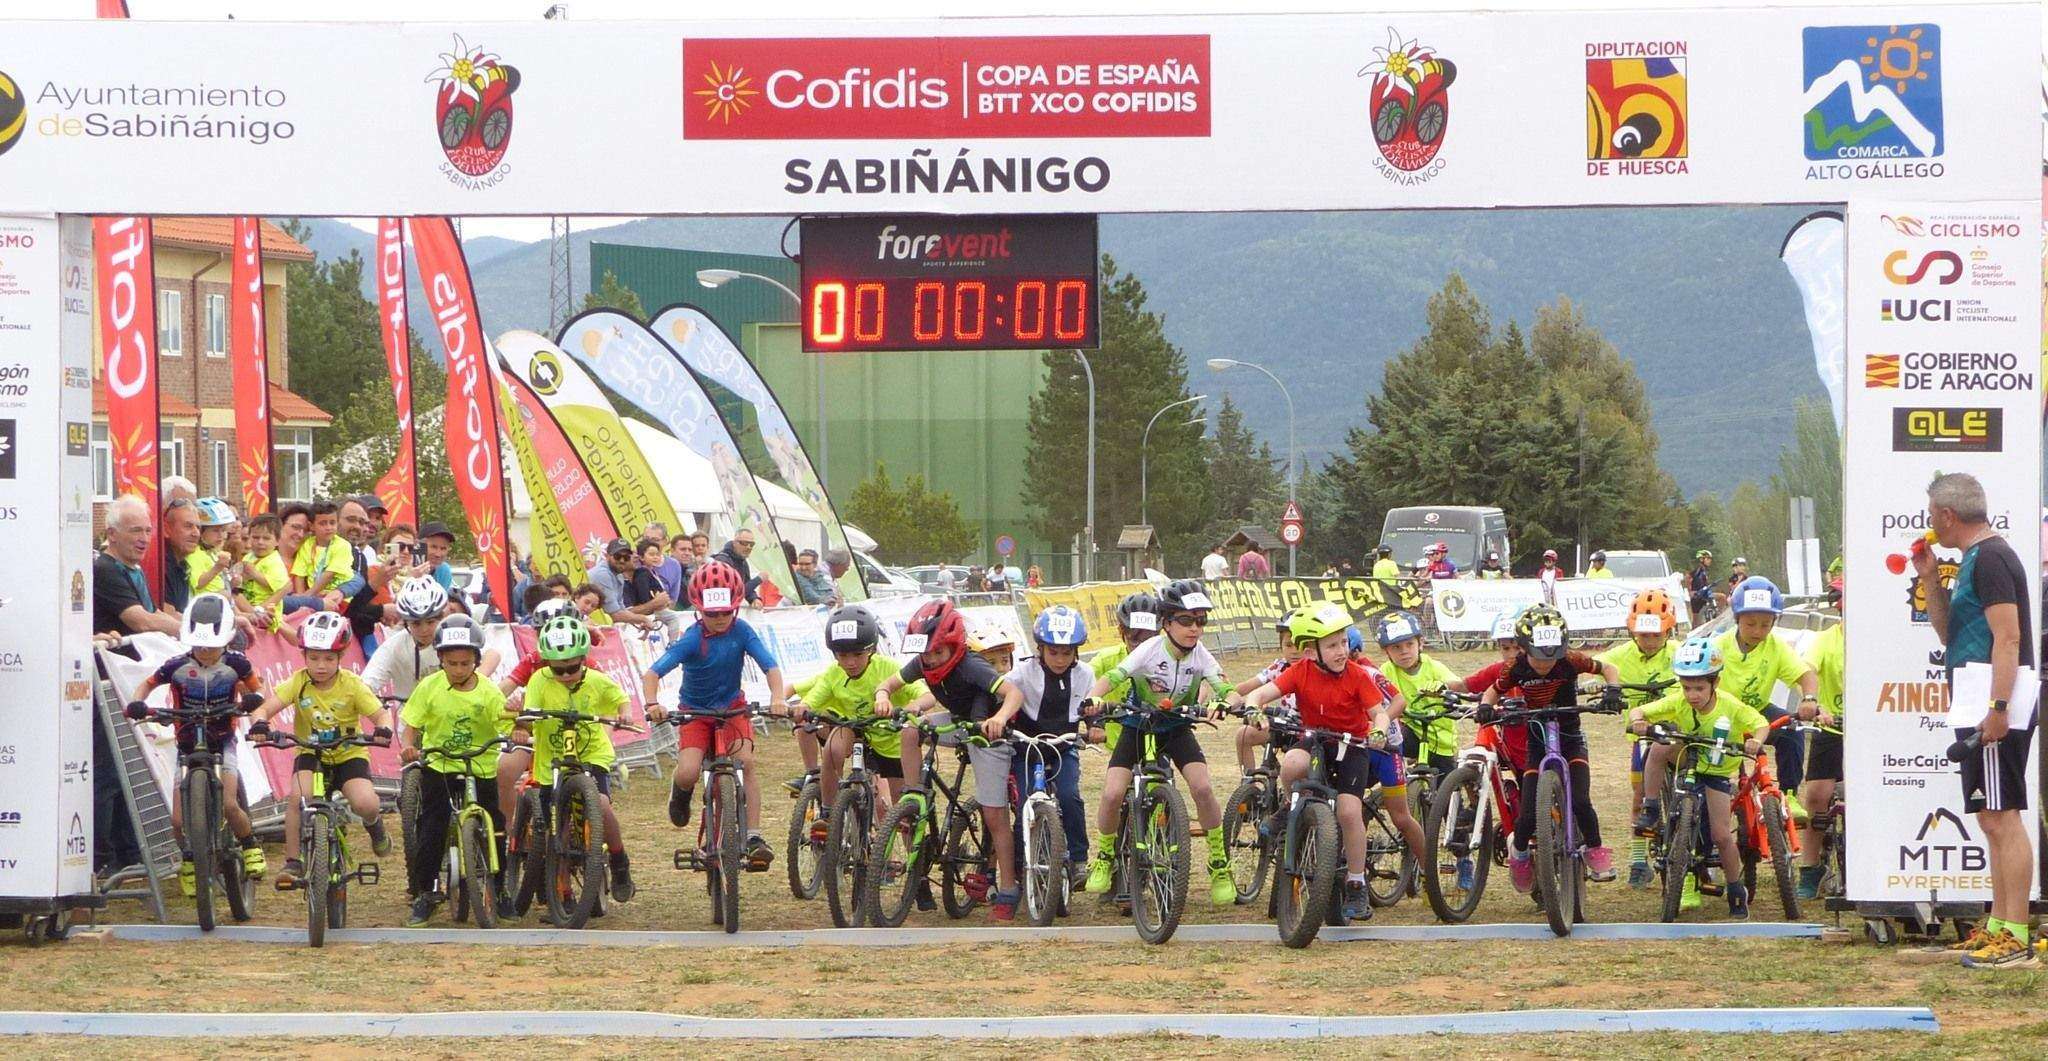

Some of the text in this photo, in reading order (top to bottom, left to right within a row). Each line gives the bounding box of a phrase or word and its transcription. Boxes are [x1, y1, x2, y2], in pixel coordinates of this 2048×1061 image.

[1585, 43, 1687, 57] DIPUTACION
[977, 58, 1200, 86] COPA DE ESPAÑA
[37, 81, 286, 111] Ayuntamiento
[765, 67, 949, 109] Cofidis
[978, 91, 1198, 114] BTT XCO COFIDIS
[1838, 146, 1909, 159] COMARCA
[785, 148, 1110, 194] SABIÑÁNIGO
[1587, 161, 1689, 177] DE HUESCA
[1805, 160, 1944, 181] ALTO GÁLLEGO
[1930, 224, 2021, 238] CICLISMO
[877, 225, 1013, 260] forevent
[1971, 263, 2001, 273] Consejo
[1904, 353, 2018, 370] GOBIERNO
[1904, 373, 2033, 390] DE ARAGON
[706, 591, 727, 603] 101
[834, 621, 854, 634] 110
[1536, 629, 1560, 642] 107
[311, 632, 326, 642] 89
[446, 631, 467, 641] 108
[1882, 754, 1949, 770] iberCaja
[1882, 776, 1925, 789] Leasing
[1900, 845, 1987, 871] MTB
[1887, 875, 1994, 889] PYRENEES
